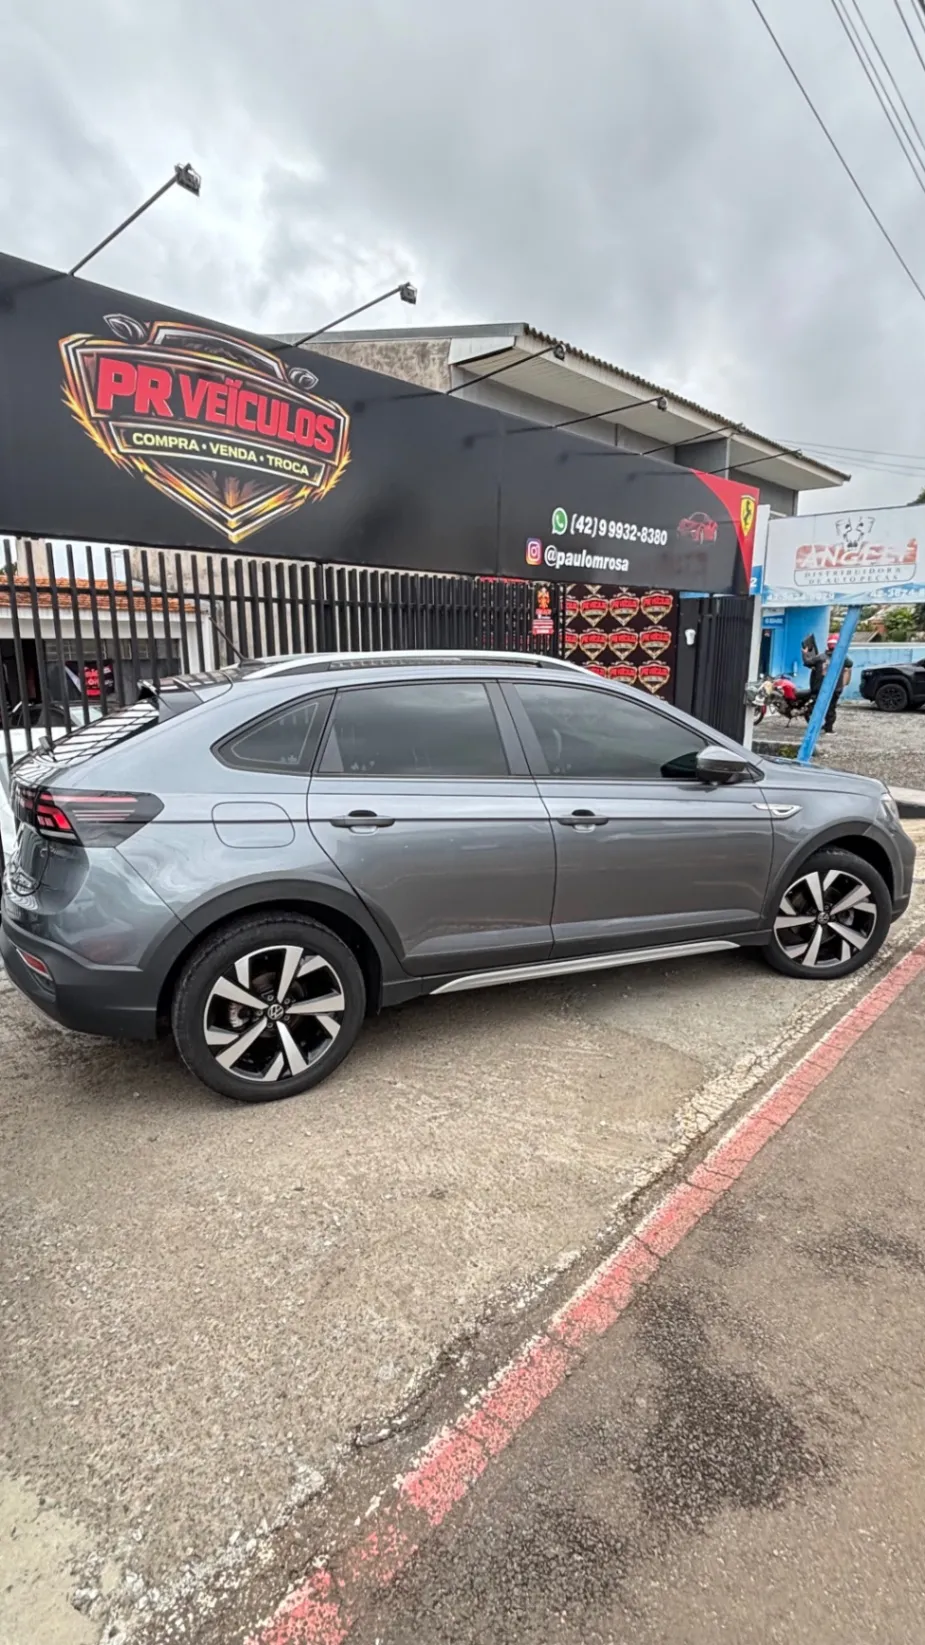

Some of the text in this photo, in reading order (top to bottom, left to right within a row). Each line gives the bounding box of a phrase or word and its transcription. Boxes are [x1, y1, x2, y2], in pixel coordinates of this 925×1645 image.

[96, 357, 174, 418] PR
[132, 432, 310, 477] COMPRA VENDA TROCA
[544, 544, 630, 572] @paulomrosa
